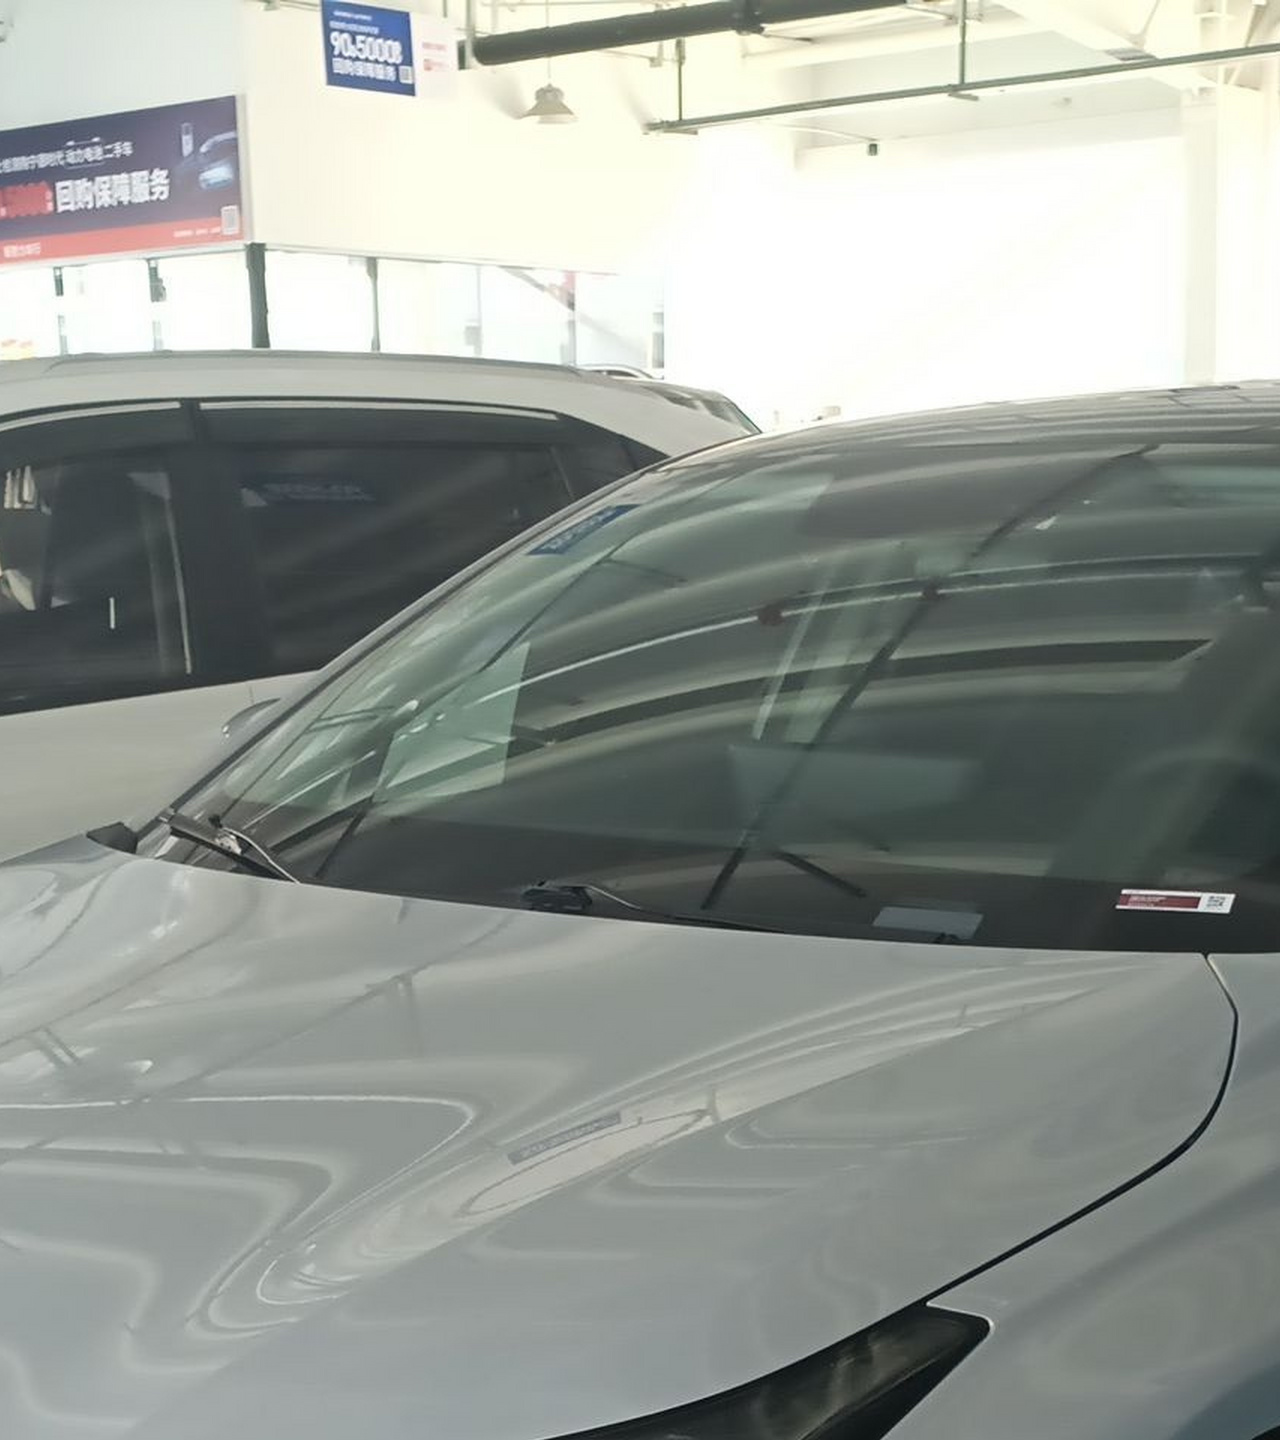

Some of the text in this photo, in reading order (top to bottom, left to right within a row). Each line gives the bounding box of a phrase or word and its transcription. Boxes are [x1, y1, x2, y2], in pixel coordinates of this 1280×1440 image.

[55, 168, 170, 213] 回购保障服务
